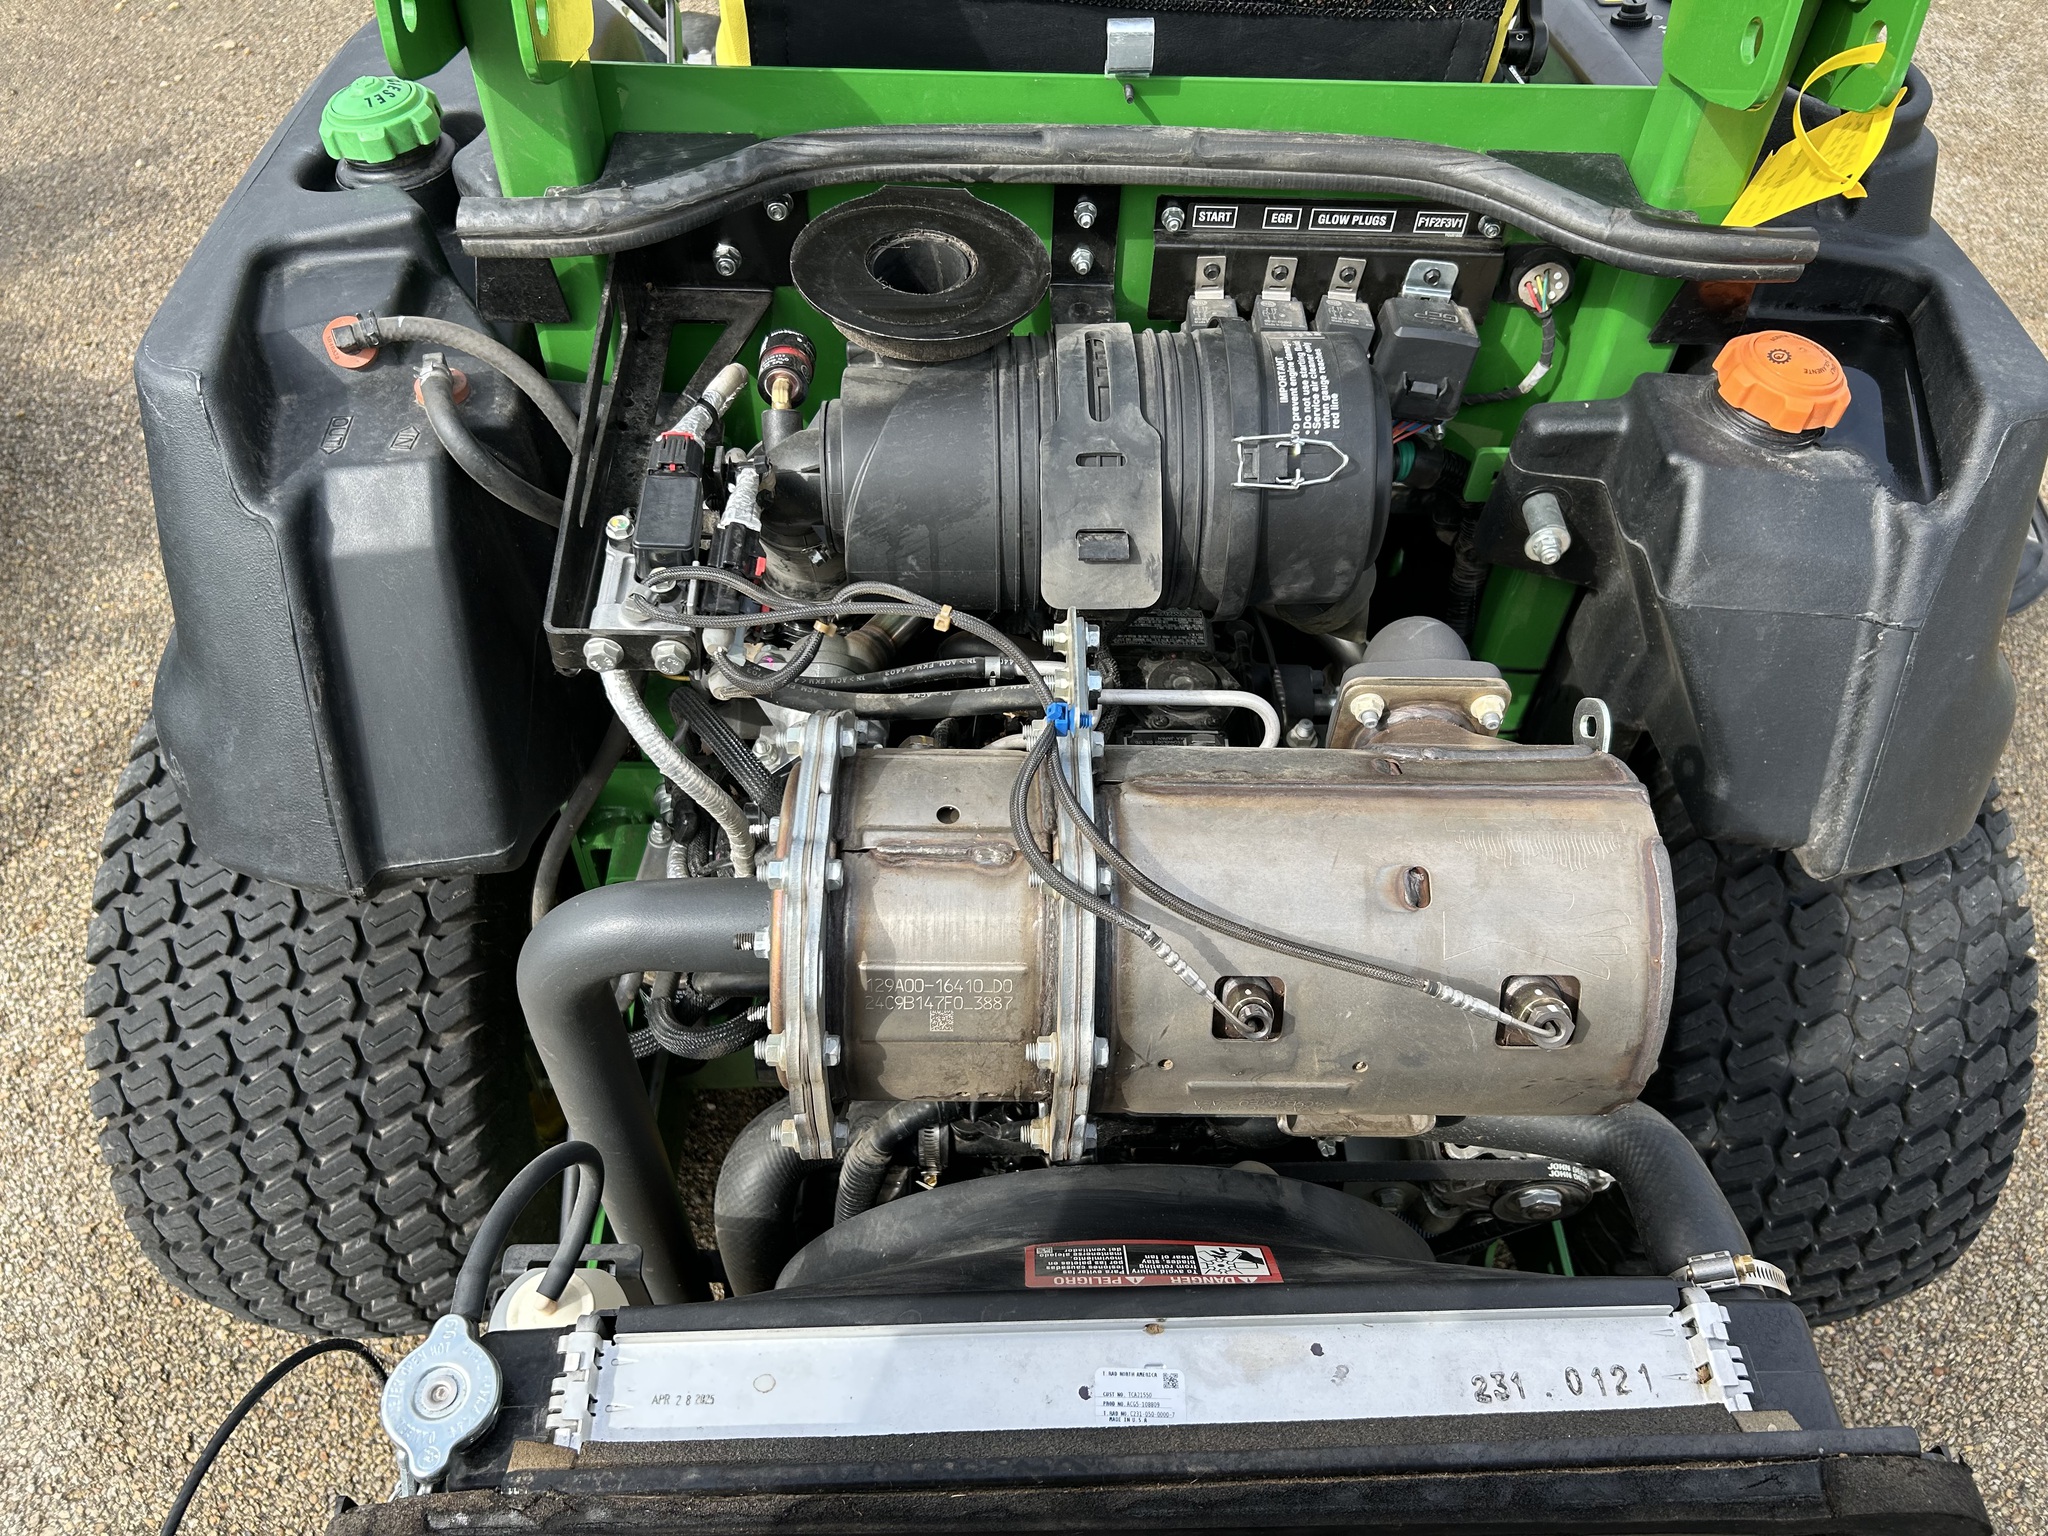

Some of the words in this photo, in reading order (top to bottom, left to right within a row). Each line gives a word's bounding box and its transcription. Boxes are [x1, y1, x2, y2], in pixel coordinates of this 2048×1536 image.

[364, 79, 402, 108] DIESEL
[1198, 211, 1232, 223] START
[1270, 213, 1293, 224] EGR
[1317, 214, 1350, 226] GLOW
[1351, 215, 1387, 227] PLUGS
[1417, 217, 1464, 229] F1F2F3V1
[1302, 342, 1313, 353] only
[1297, 352, 1308, 379] starting
[1307, 354, 1317, 379] cleaner
[1314, 348, 1326, 374] reaches
[1275, 356, 1289, 404] IMPORTANT
[1287, 361, 1298, 387] engine
[1302, 380, 1310, 396] use
[1310, 380, 1319, 392] air
[1320, 375, 1331, 402] gauge
[1290, 387, 1301, 421] prevent
[1302, 397, 1311, 413] not
[1330, 393, 1339, 411] line
[1312, 393, 1321, 429] Service
[1322, 403, 1331, 430] when
[1303, 415, 1312, 429] Do
[1330, 412, 1340, 429] red
[325, 417, 349, 449] OUT
[1291, 423, 1300, 435] To
[395, 432, 413, 449] IN
[1547, 1162, 1571, 1172] JOHN
[1548, 1170, 1572, 1179] JOHN
[1053, 1276, 1122, 1285] PELIGRO
[1170, 1276, 1236, 1284] DANGER
[402, 1351, 428, 1376] OPEN
[430, 1340, 451, 1357] HOT
[651, 1393, 671, 1405] APR
[695, 1393, 715, 1405] 2025
